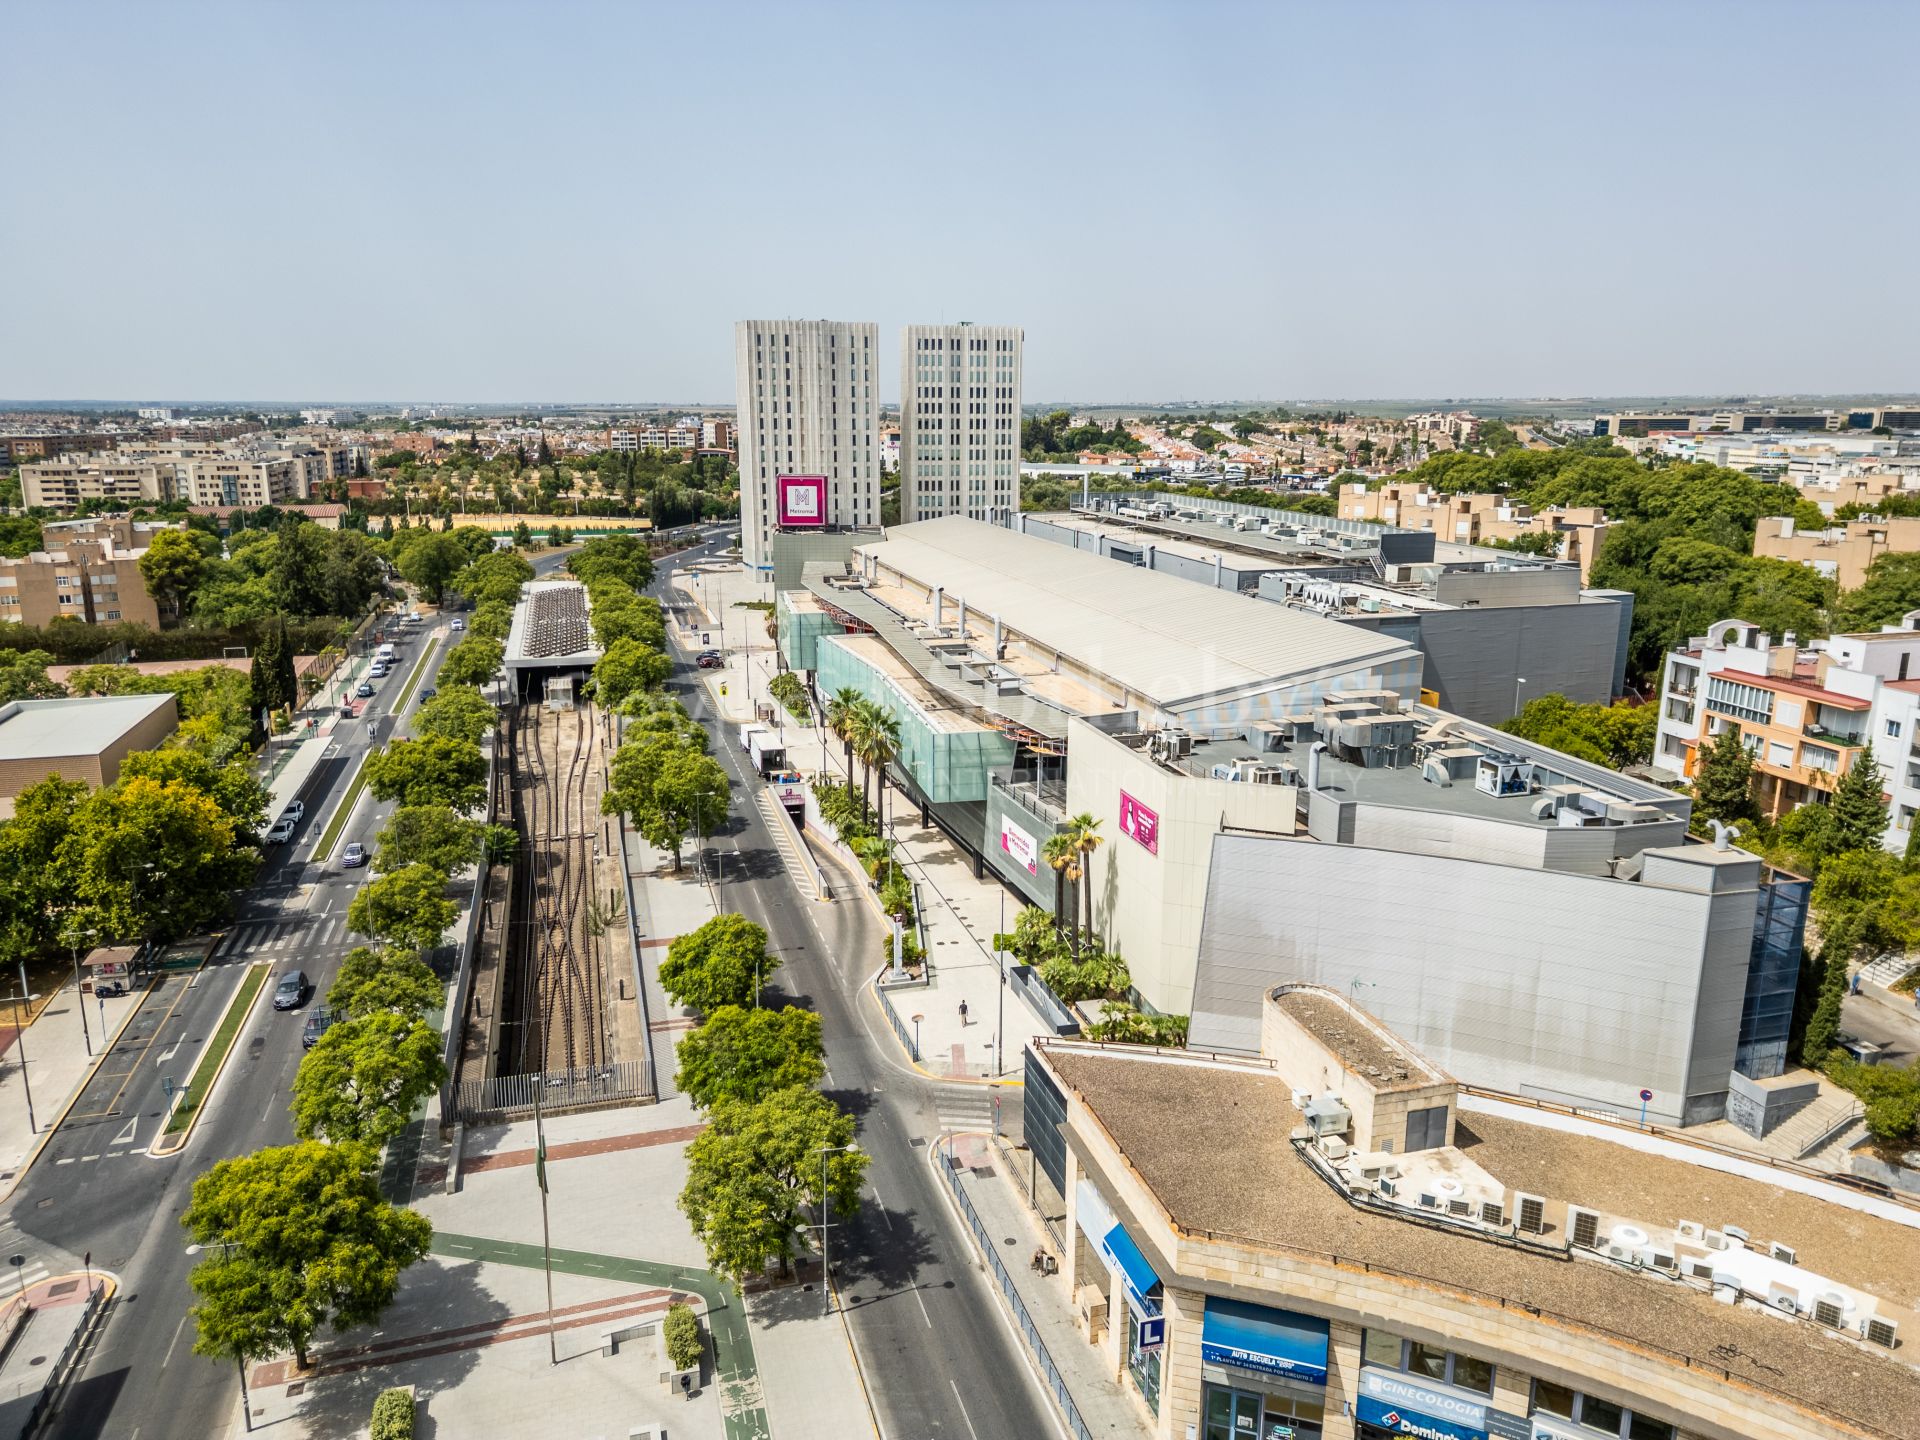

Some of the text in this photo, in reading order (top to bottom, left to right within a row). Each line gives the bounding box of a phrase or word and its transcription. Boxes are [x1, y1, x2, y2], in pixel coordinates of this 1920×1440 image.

[1144, 1323, 1160, 1344] L
[1216, 1356, 1236, 1366] PLANTA
[1249, 1364, 1273, 1374] ENTRADA
[1273, 1368, 1284, 1376] POR
[1285, 1371, 1308, 1381] CIRCUITO
[1231, 1350, 1248, 1360] AUTO
[1249, 1353, 1276, 1366] ESCUELA
[1382, 1382, 1480, 1417] GINECOLOGIA
